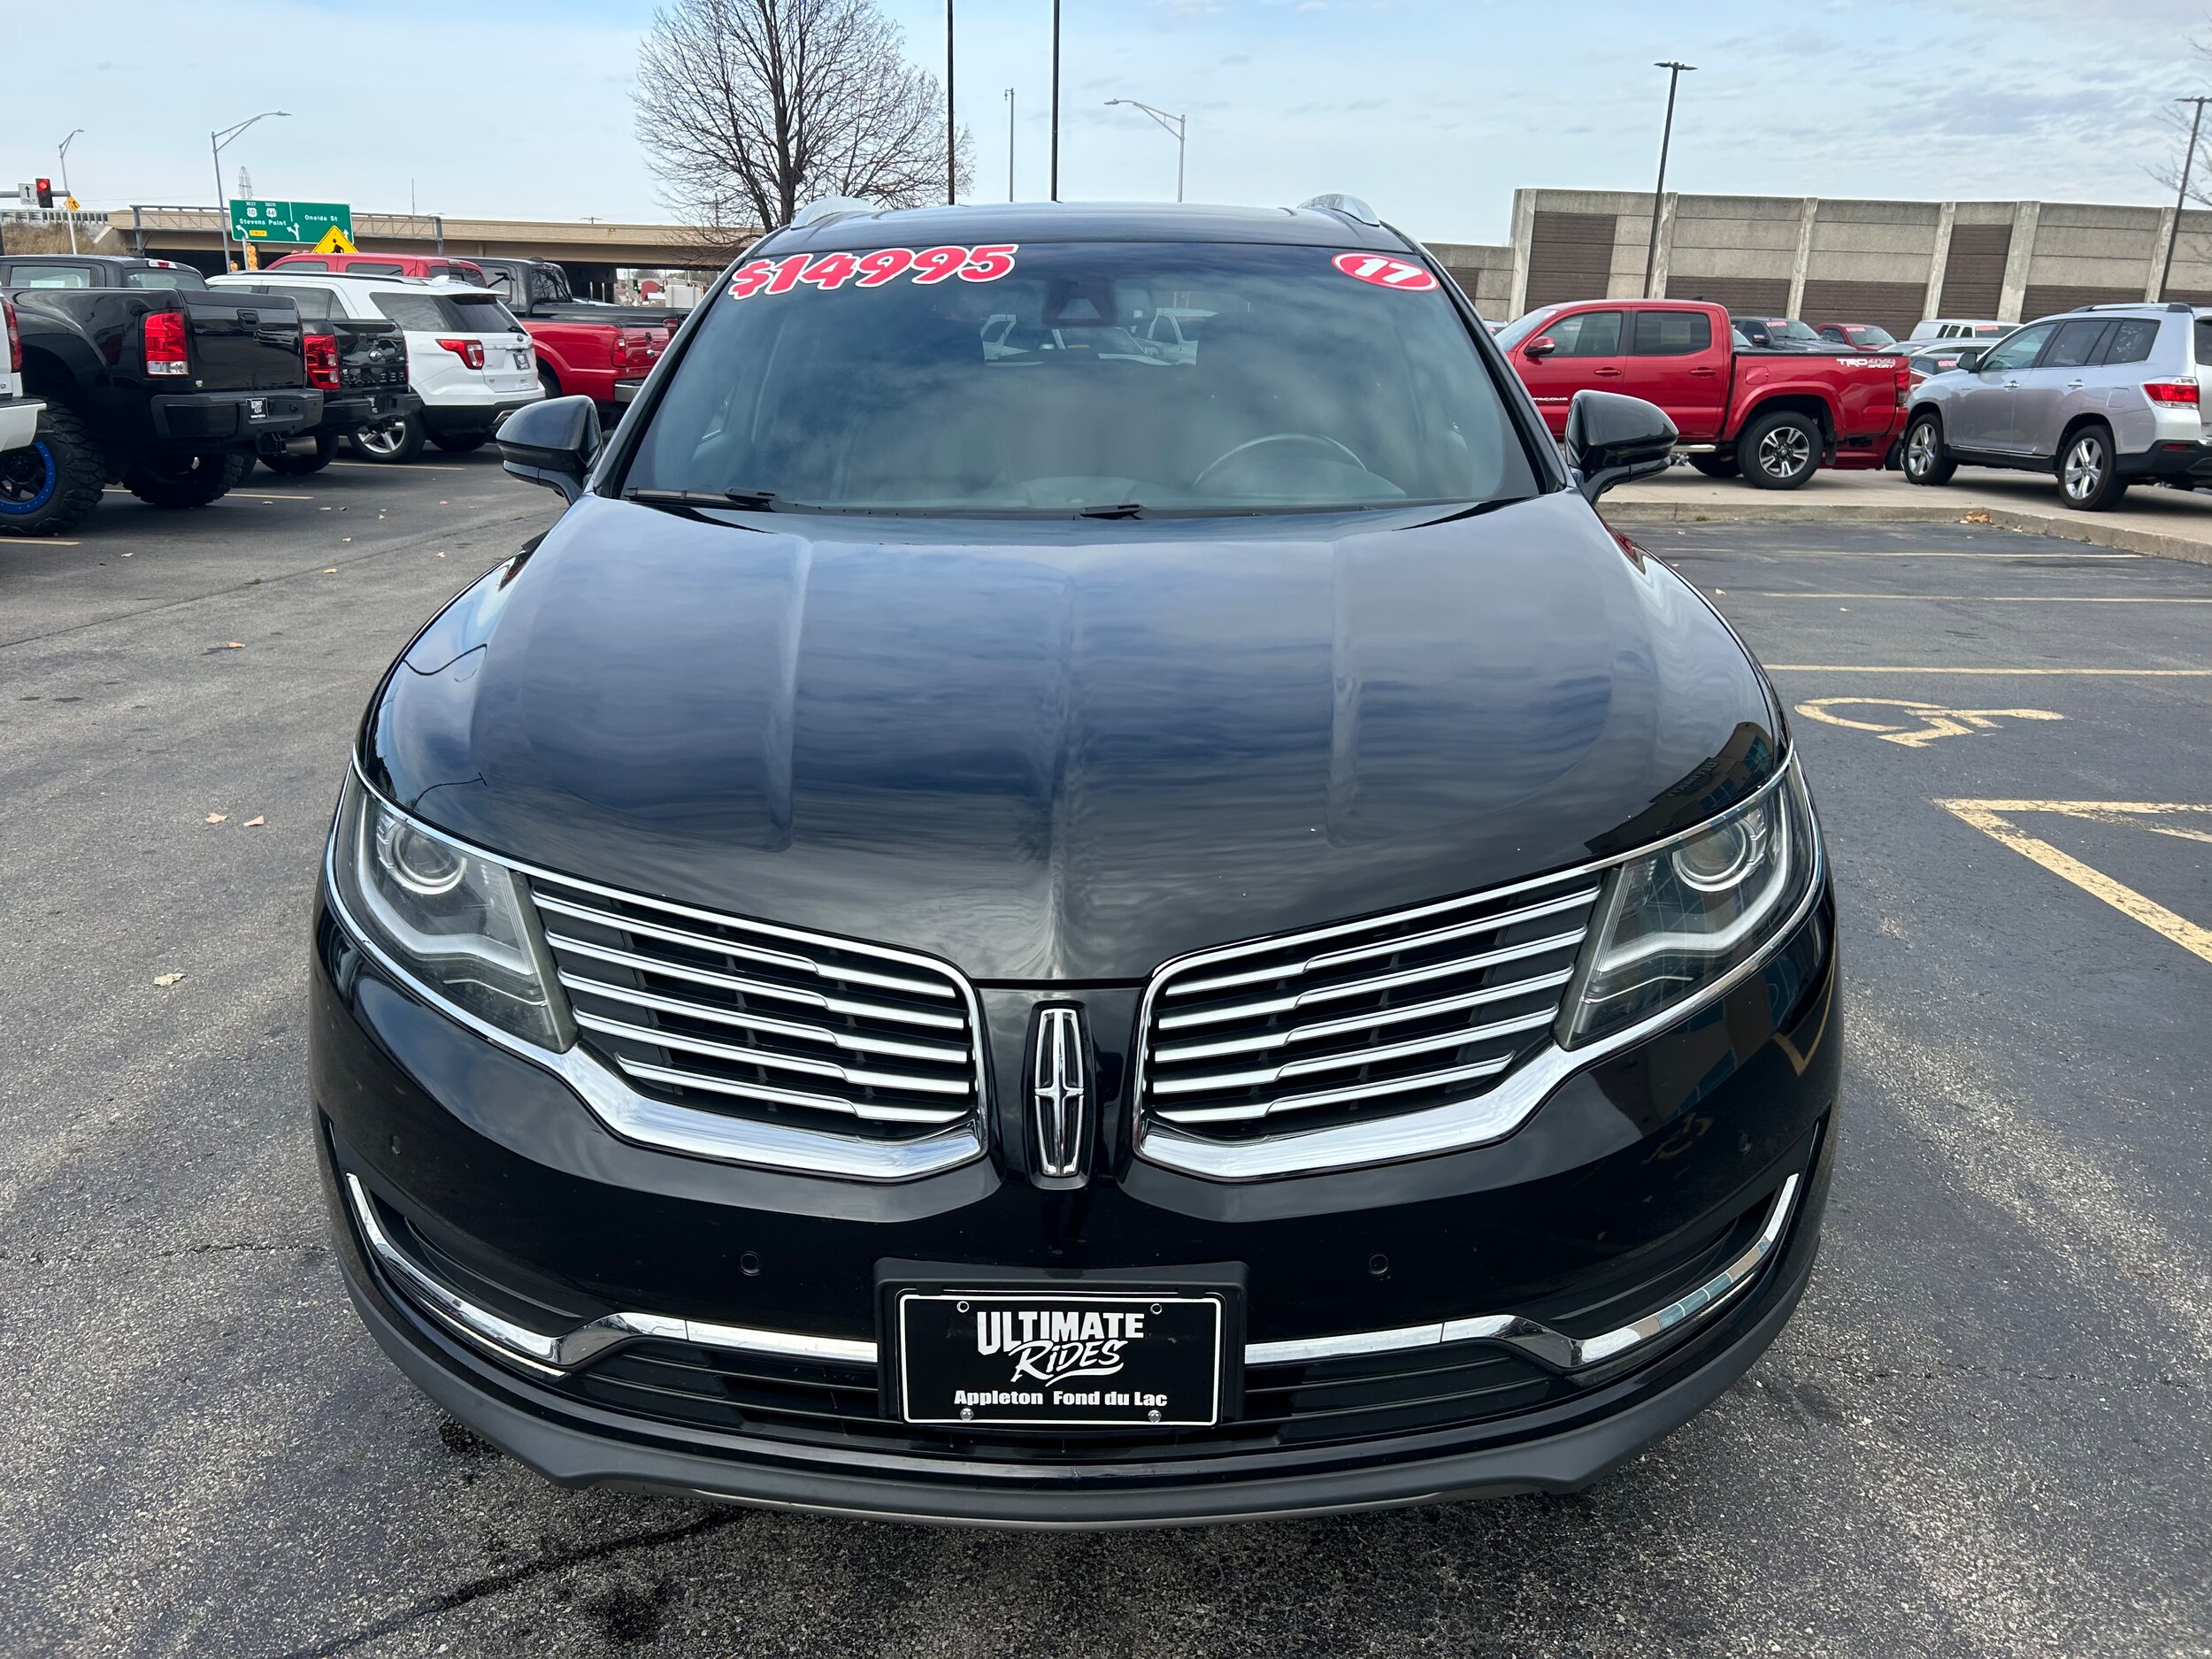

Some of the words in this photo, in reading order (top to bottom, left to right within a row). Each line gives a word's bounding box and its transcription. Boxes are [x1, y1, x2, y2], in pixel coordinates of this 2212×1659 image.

[728, 244, 1018, 300] $14995
[1354, 257, 1424, 284] 17
[1836, 358, 1868, 368] TRD
[976, 1310, 1145, 1356] ULTIMATE
[954, 1390, 1043, 1406] Appleton
[1053, 1390, 1100, 1406] Fond
[1104, 1390, 1132, 1407] du
[1133, 1391, 1168, 1408] Lac
